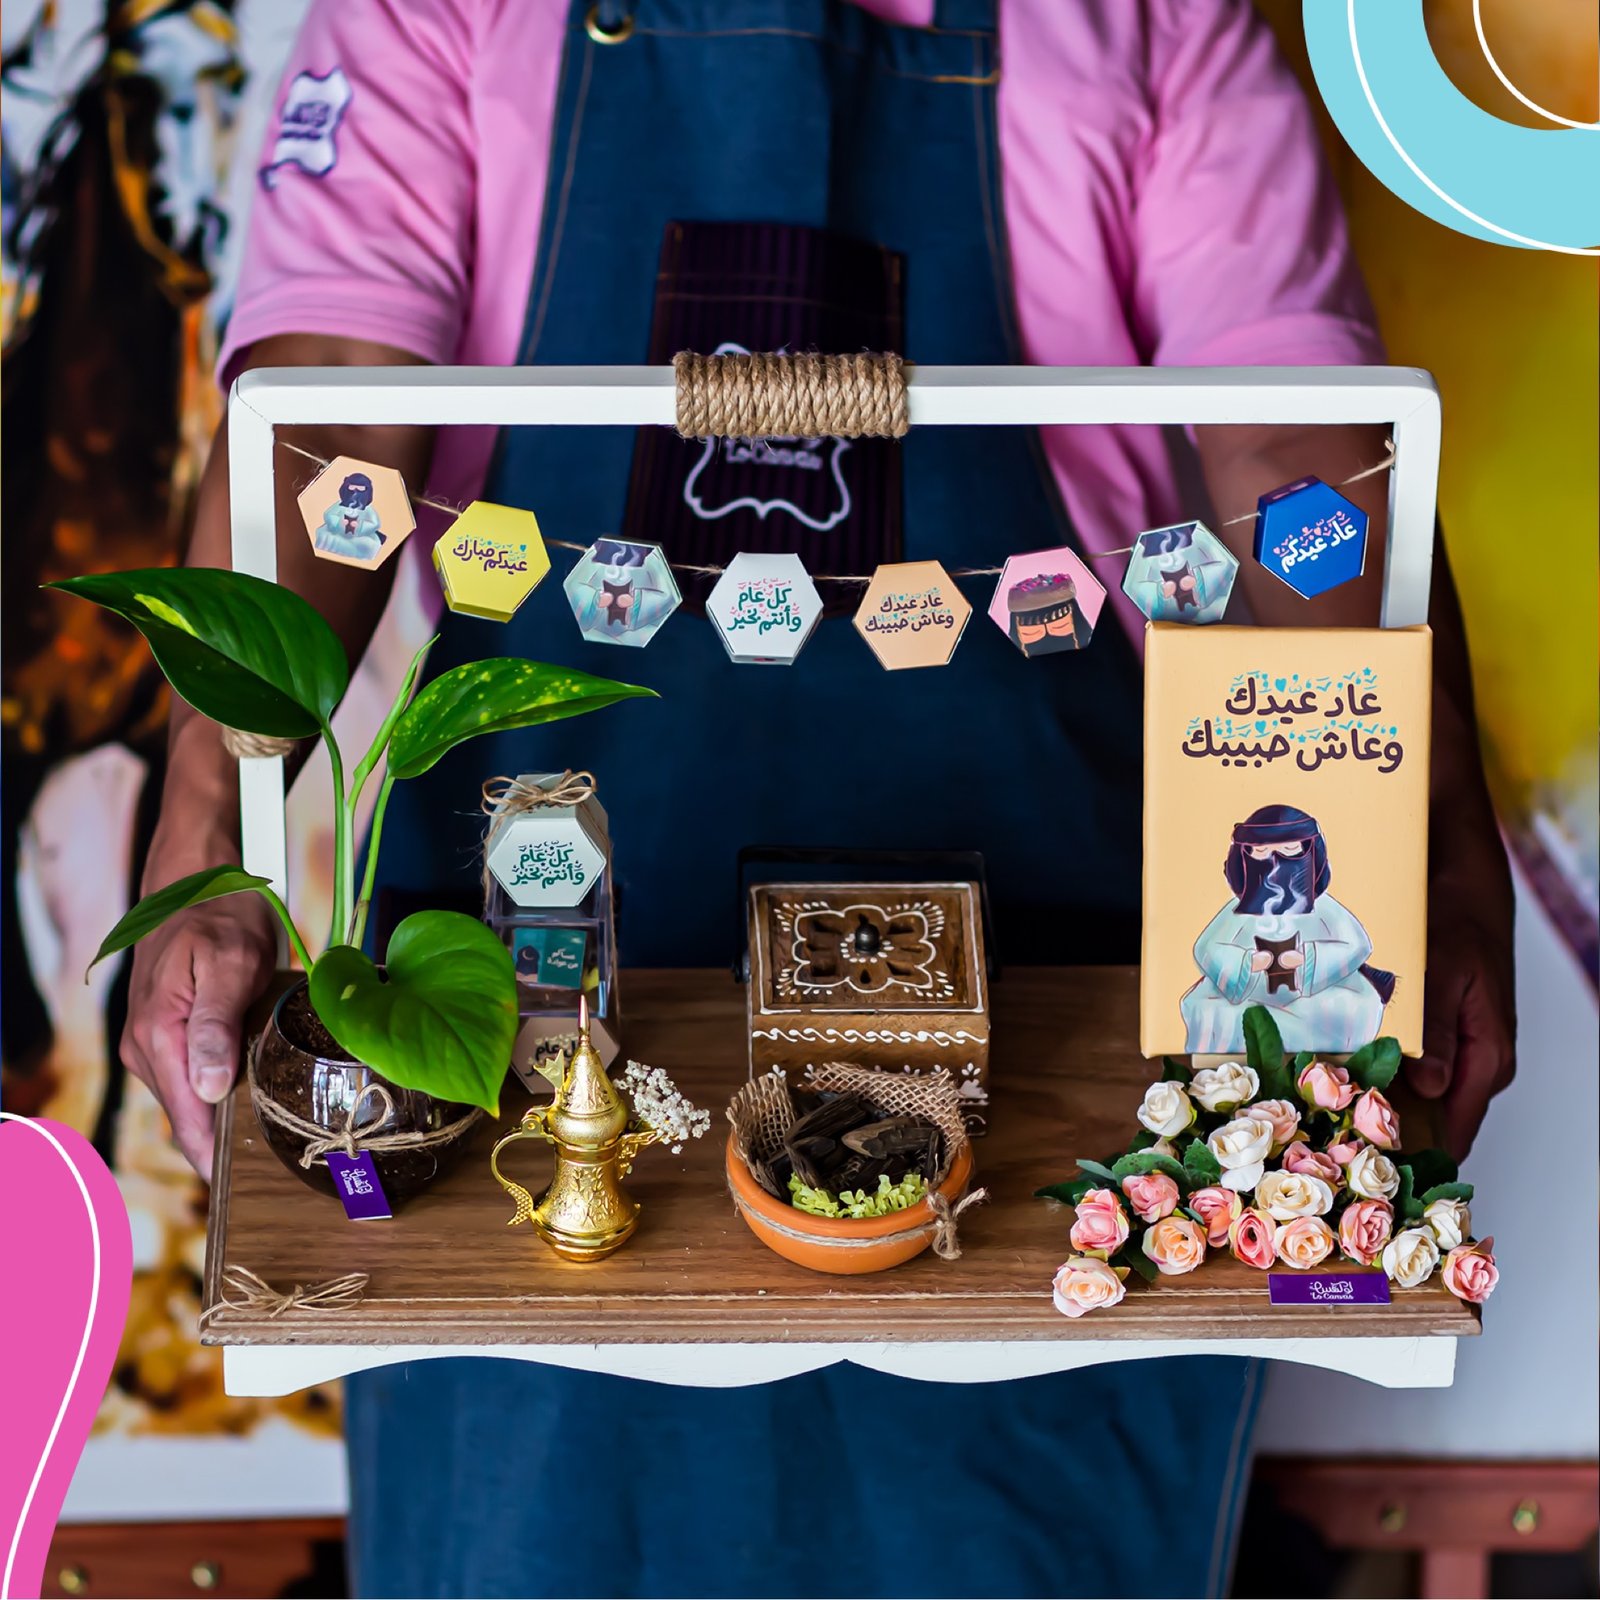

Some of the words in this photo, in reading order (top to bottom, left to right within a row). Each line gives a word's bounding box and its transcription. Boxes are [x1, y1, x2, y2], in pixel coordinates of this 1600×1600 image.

[1330, 519, 1358, 548] عاد
[452, 539, 496, 561] مبارك
[1281, 536, 1328, 573] عيدكم
[483, 550, 528, 575] عيدكم
[738, 585, 765, 611] عام
[766, 586, 793, 610] كل
[880, 595, 918, 614] عيدك
[919, 593, 944, 609] عاد
[726, 607, 761, 631] بخير
[759, 605, 802, 635] وأنتم
[864, 615, 909, 634] حبيبك
[910, 611, 955, 632] وعاش
[1225, 676, 1319, 725] عيدك
[1323, 681, 1382, 718] عاد
[1181, 718, 1291, 768] حبيبك
[1296, 727, 1404, 774] وعاش
[519, 848, 546, 869] عام
[548, 848, 574, 868] كل
[509, 866, 544, 886] بخير
[541, 863, 585, 889] وأنتم
